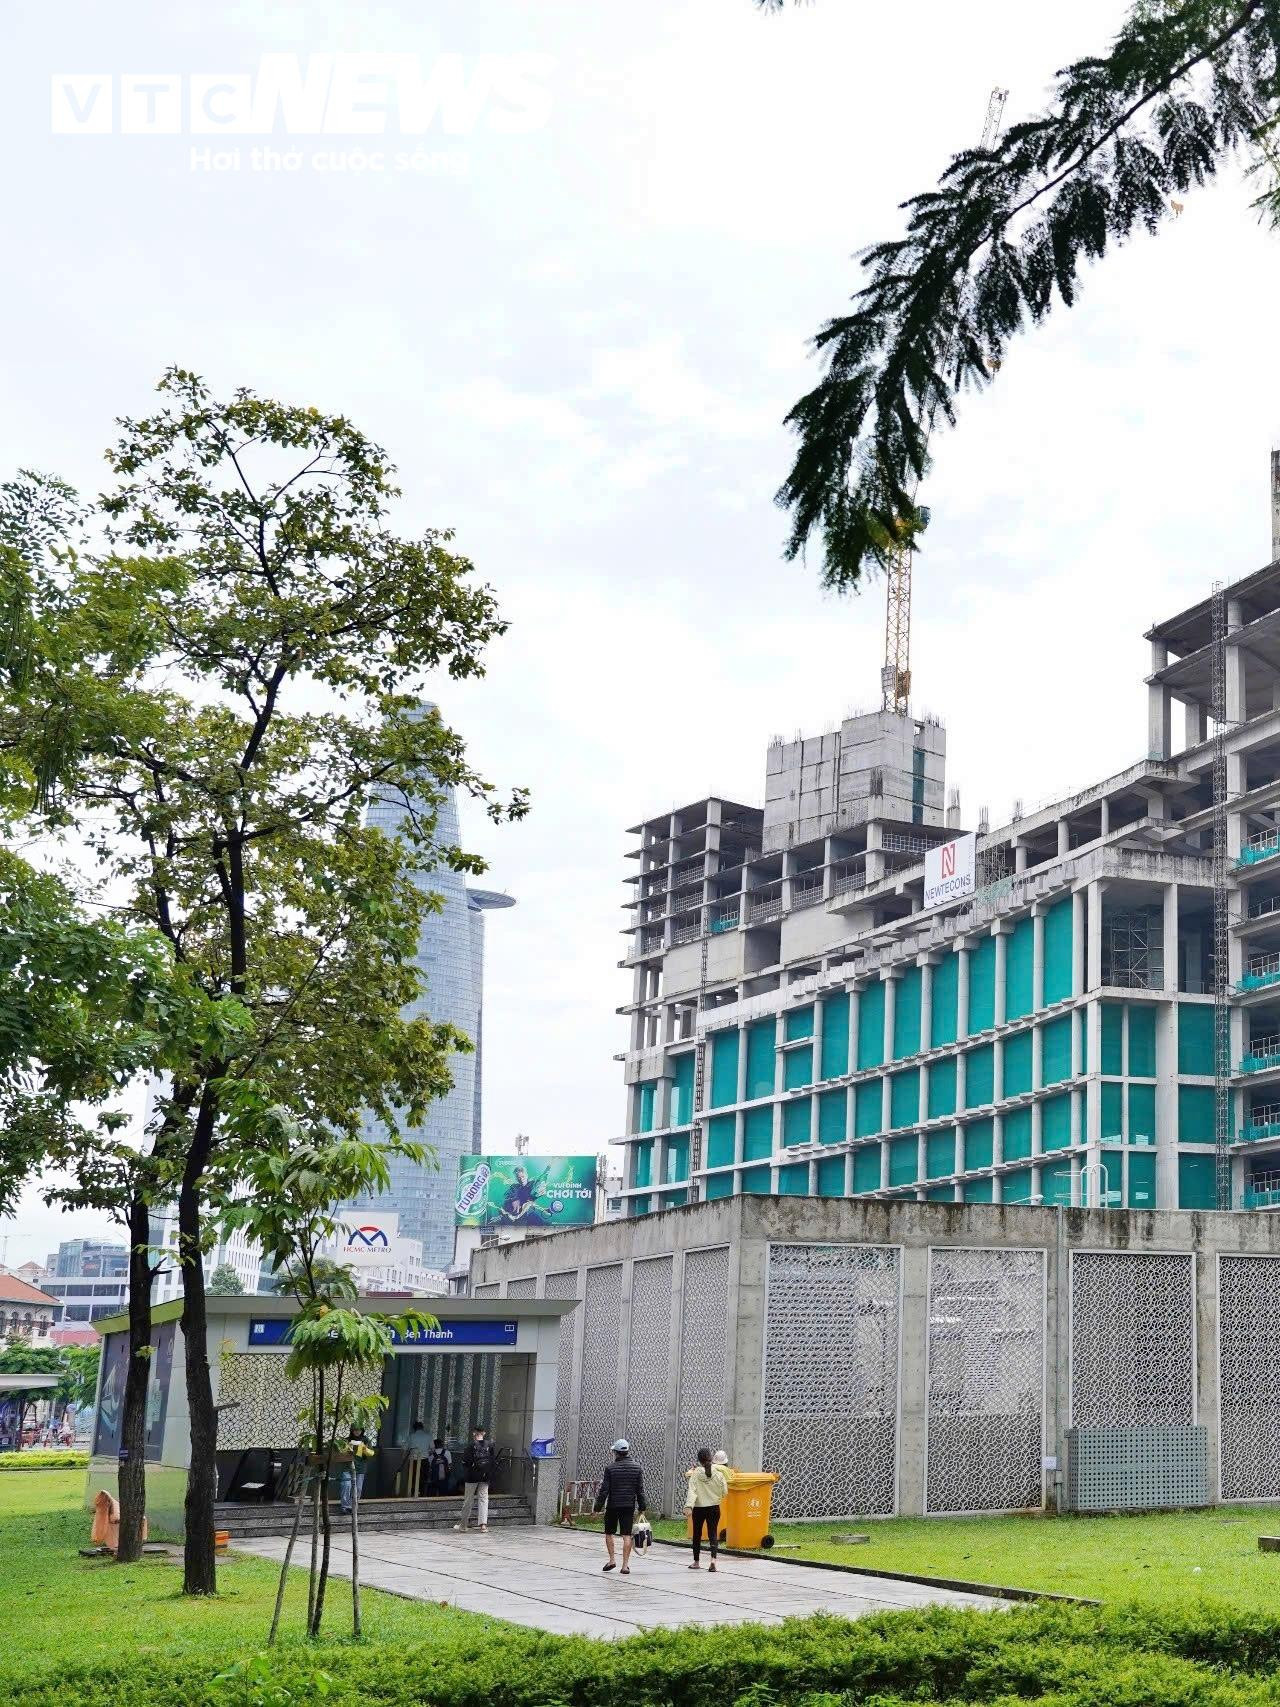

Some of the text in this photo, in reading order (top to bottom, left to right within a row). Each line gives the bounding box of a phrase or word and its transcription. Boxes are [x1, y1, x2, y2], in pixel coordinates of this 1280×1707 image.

[925, 875, 971, 900] NEWTECONS
[457, 1173, 487, 1211] TUBORG
[424, 1329, 453, 1339] Thanh
